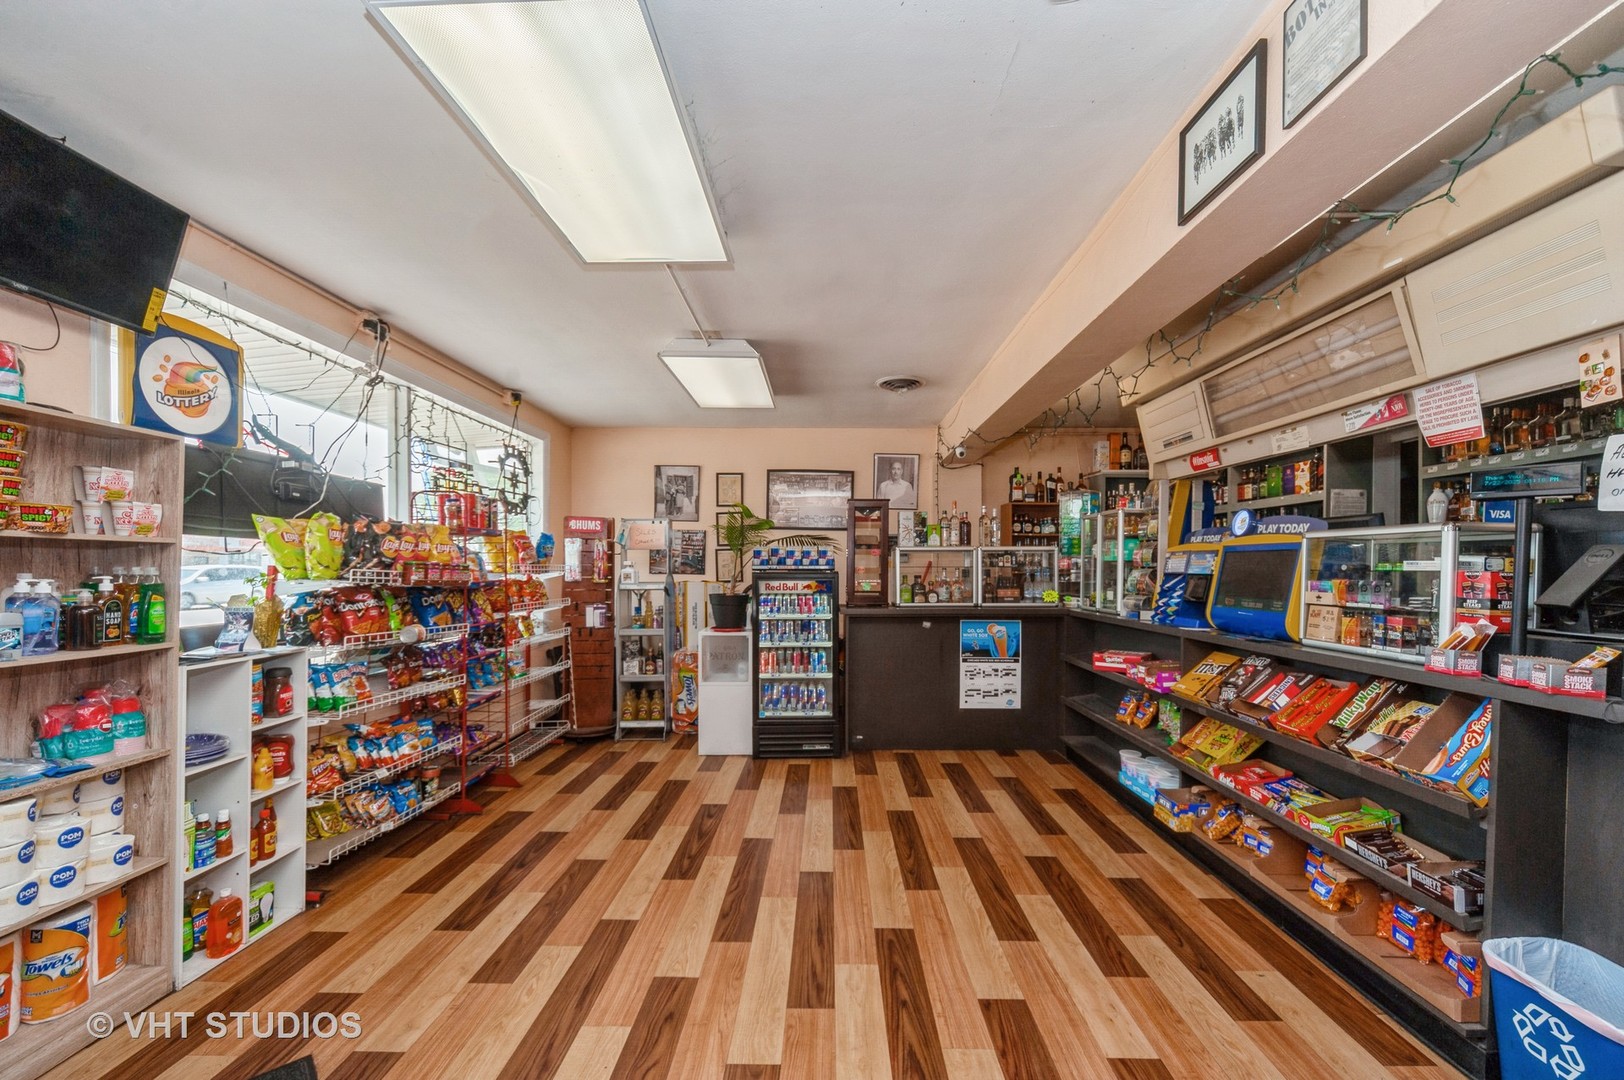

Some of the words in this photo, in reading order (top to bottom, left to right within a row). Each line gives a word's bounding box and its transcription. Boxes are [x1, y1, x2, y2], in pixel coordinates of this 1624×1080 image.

[156, 385, 217, 408] LOTTERY
[21, 506, 45, 514] HOT
[1489, 509, 1511, 518] VISA
[21, 513, 51, 522] SPICY
[571, 519, 601, 530] CHUMS
[1258, 524, 1278, 534] PLAY
[1279, 522, 1310, 533] TODAY
[1190, 535, 1202, 543] PLAY
[1203, 534, 1221, 542] TODAY
[1564, 674, 1594, 683] SMOKE
[683, 674, 696, 706] Towels
[1564, 681, 1592, 690] STACK
[61, 830, 82, 842] POM
[115, 848, 132, 860] POM
[53, 869, 75, 882] POM
[1411, 868, 1442, 893] HERSHEY'S
[20, 885, 38, 899] POM
[24, 952, 75, 976] Towels
